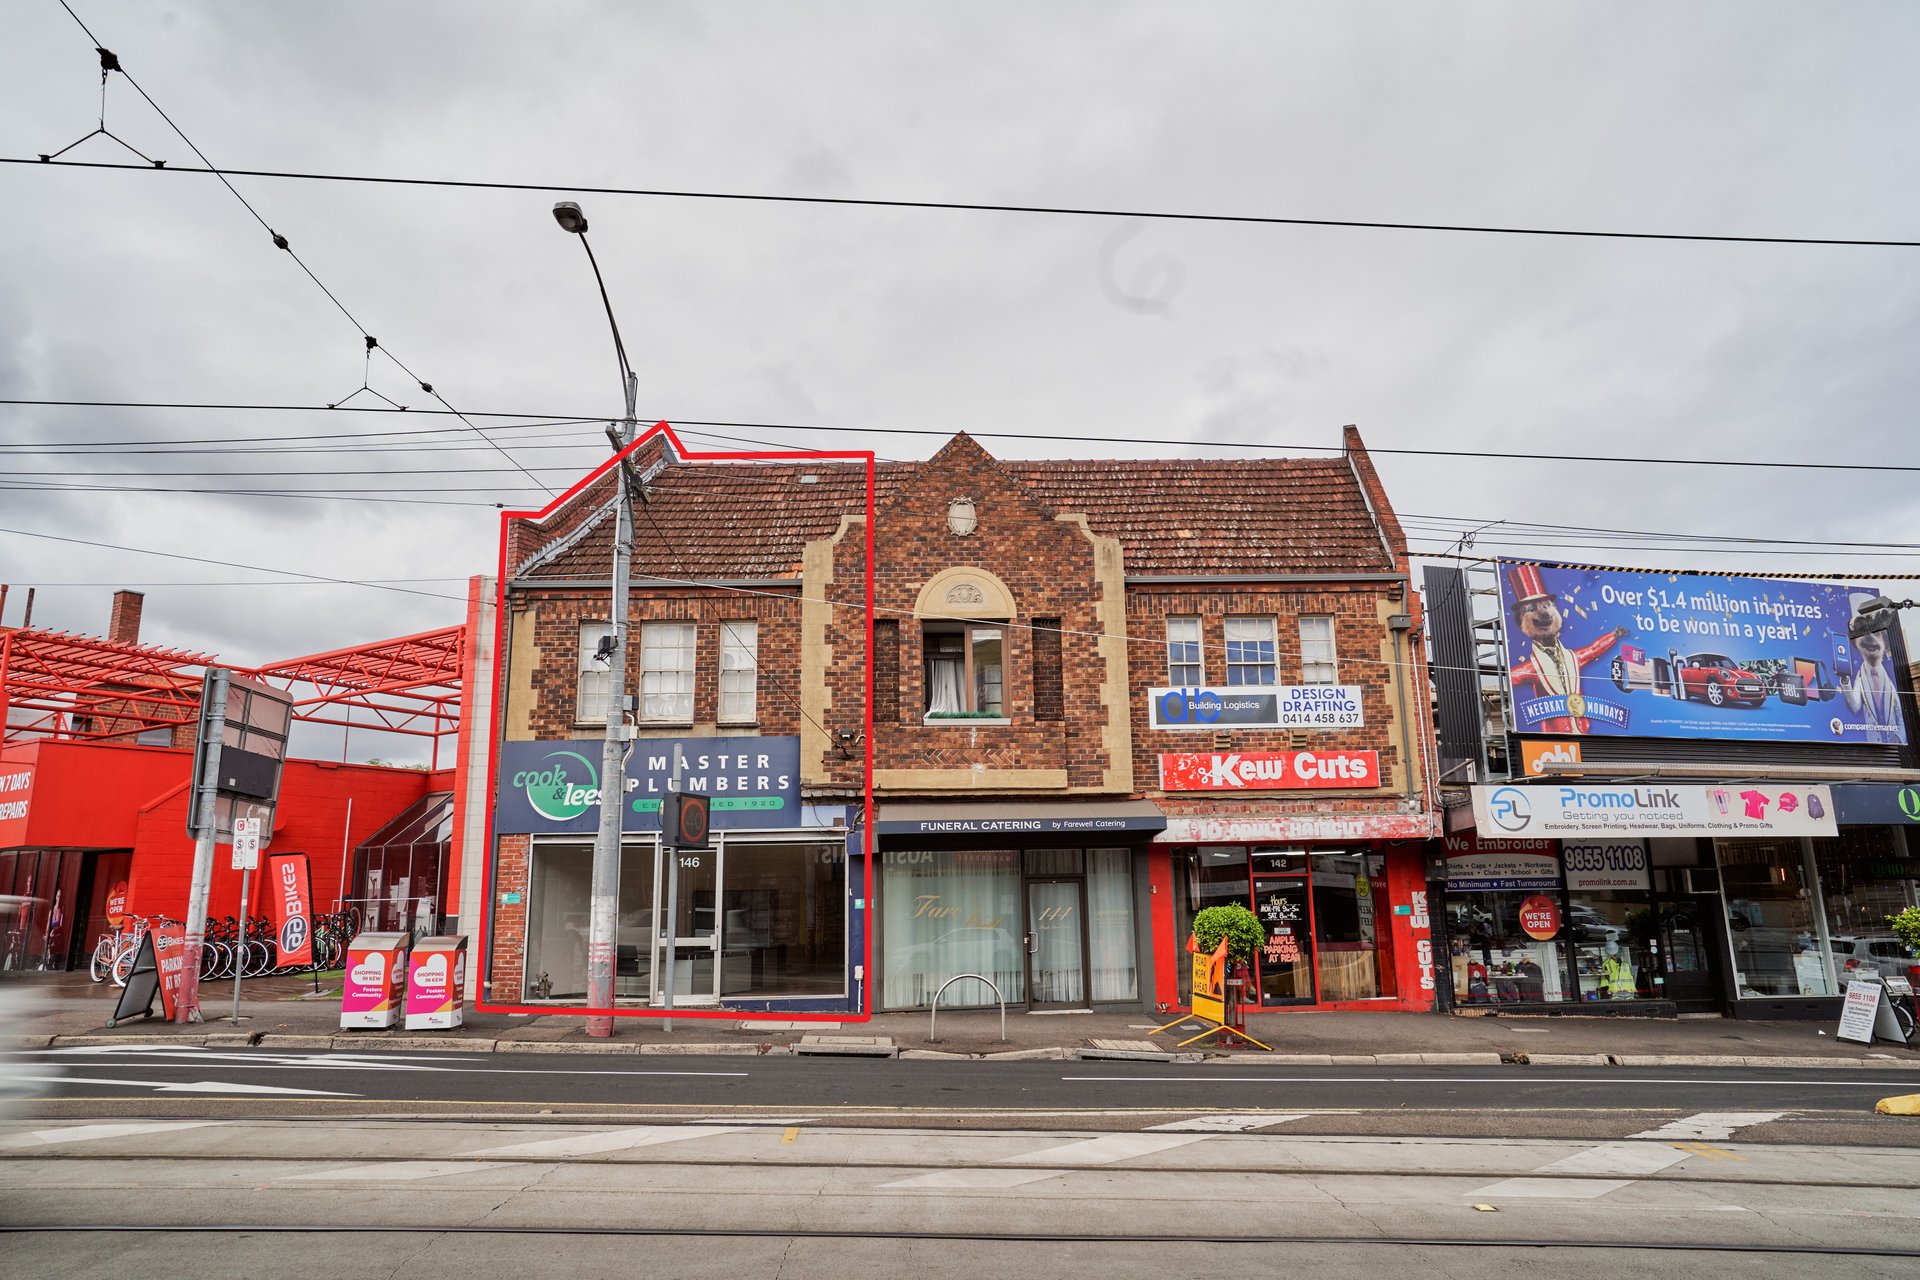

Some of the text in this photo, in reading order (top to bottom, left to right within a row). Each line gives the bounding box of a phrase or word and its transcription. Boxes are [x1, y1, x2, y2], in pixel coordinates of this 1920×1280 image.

[1602, 585, 1822, 622] Over $1.4 million in prizes
[1636, 614, 1798, 644] to be won in a year!
[1292, 688, 1346, 700] DESIGN
[1782, 682, 1800, 698] JBL
[1161, 688, 1221, 723] db
[1189, 701, 1260, 711] Building Logistics
[1284, 700, 1356, 712] DRAFTING
[1527, 700, 1564, 718] MEERKAT
[1588, 701, 1624, 721] MONDAYS
[1283, 713, 1359, 724] 0414 458 637
[1211, 752, 1368, 787] Kew Cuts
[10, 772, 31, 791] DAYS
[513, 764, 567, 788] cook
[552, 788, 565, 800] &
[1560, 788, 1680, 808] PromoLink
[0, 800, 28, 820] REPAIRS
[1562, 811, 1683, 821] Getting you noticed
[921, 822, 977, 831] FUNERAL
[981, 821, 1041, 830] CATERING
[1096, 820, 1126, 828] Catering
[1230, 822, 1282, 839] ADULT
[1290, 821, 1365, 837] HAIRCUT
[1446, 837, 1550, 850] We Embroider
[679, 857, 700, 868] 146
[1270, 859, 1287, 868] 142
[1564, 846, 1646, 871] 9855 1108
[1579, 878, 1637, 888] promolink.com.au
[110, 897, 124, 905] WE'RE
[1271, 895, 1287, 905] Hours
[110, 906, 123, 914] OPEN
[1410, 891, 1430, 928] KEW
[1524, 912, 1551, 920] WE'RE
[1270, 936, 1295, 944] AMPLE
[1264, 945, 1298, 954] PARKING
[161, 956, 184, 973] PARKIN
[1269, 954, 1300, 963] AT REAR
[1417, 940, 1435, 990] CUTS
[166, 975, 173, 990] AT
[1863, 994, 1876, 1002] 1108
